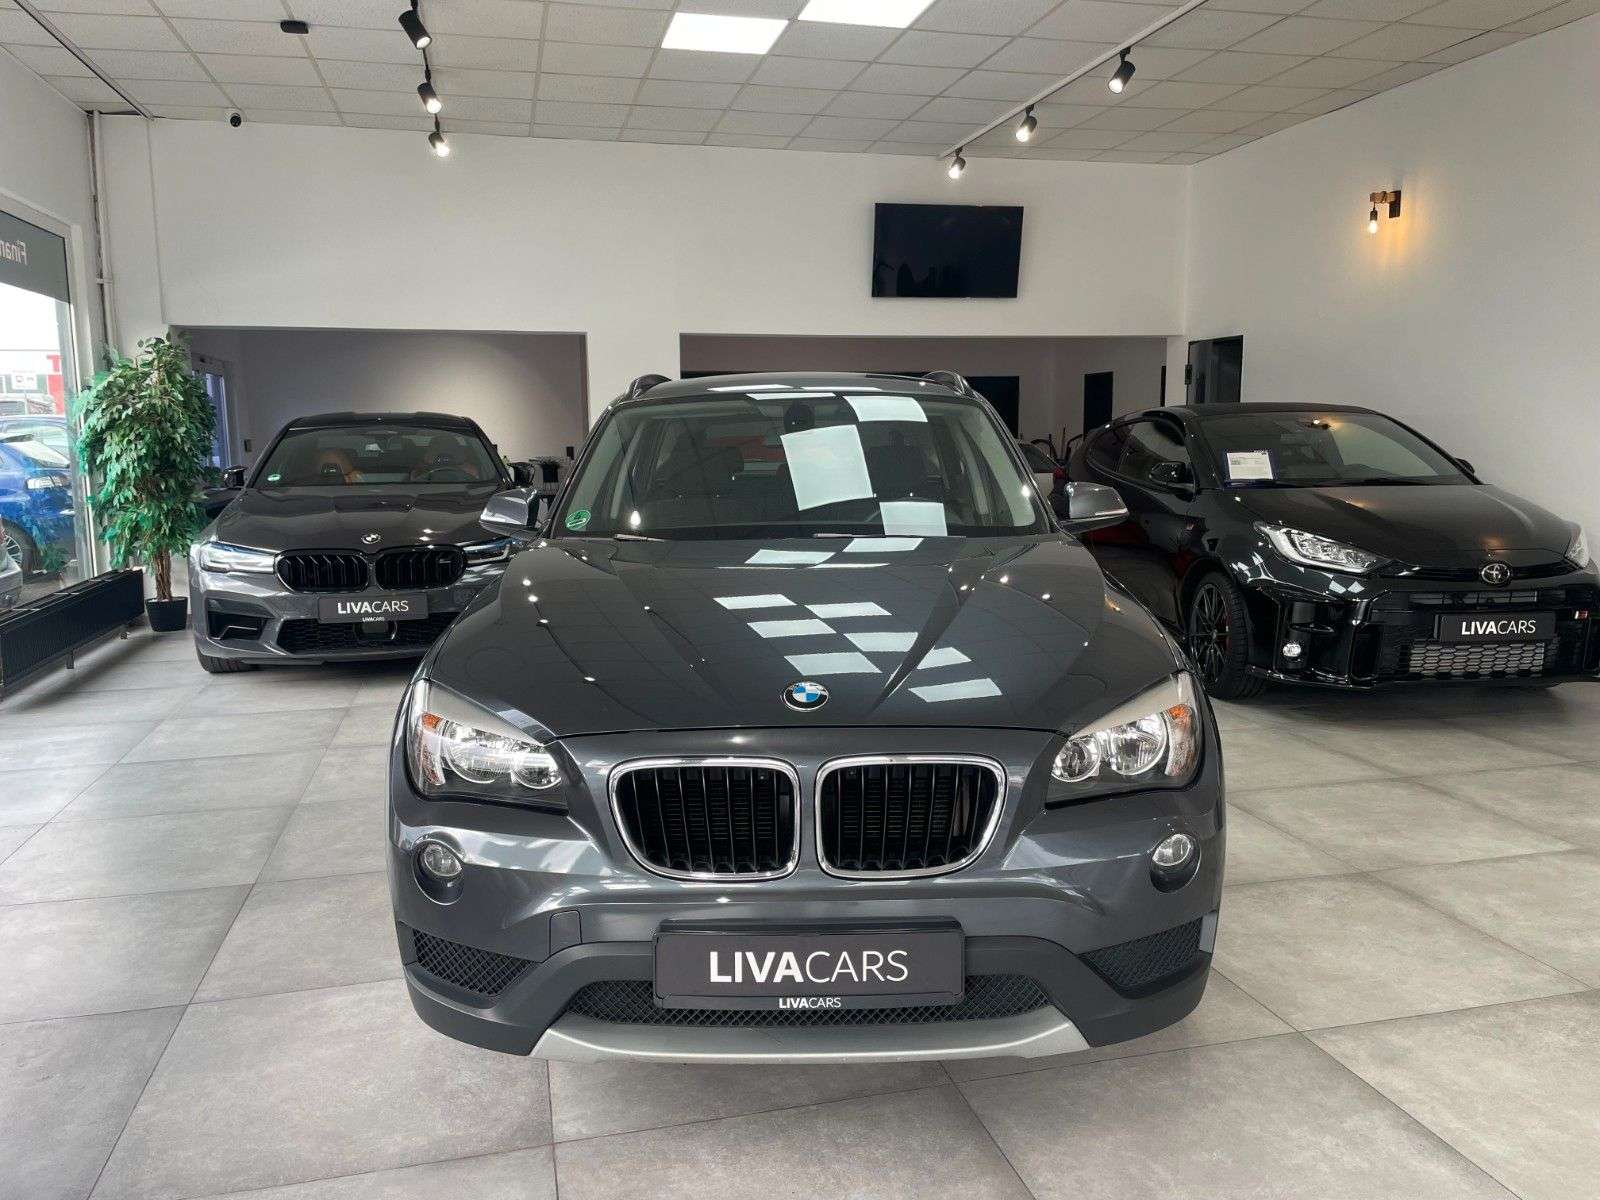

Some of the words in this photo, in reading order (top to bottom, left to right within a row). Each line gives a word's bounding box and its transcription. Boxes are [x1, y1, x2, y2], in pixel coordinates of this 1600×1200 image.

[337, 600, 409, 614] LIVACARS
[1461, 619, 1537, 635] LIVACARS
[708, 950, 909, 983] LIVACARS
[778, 996, 842, 1009] LIVACARS
